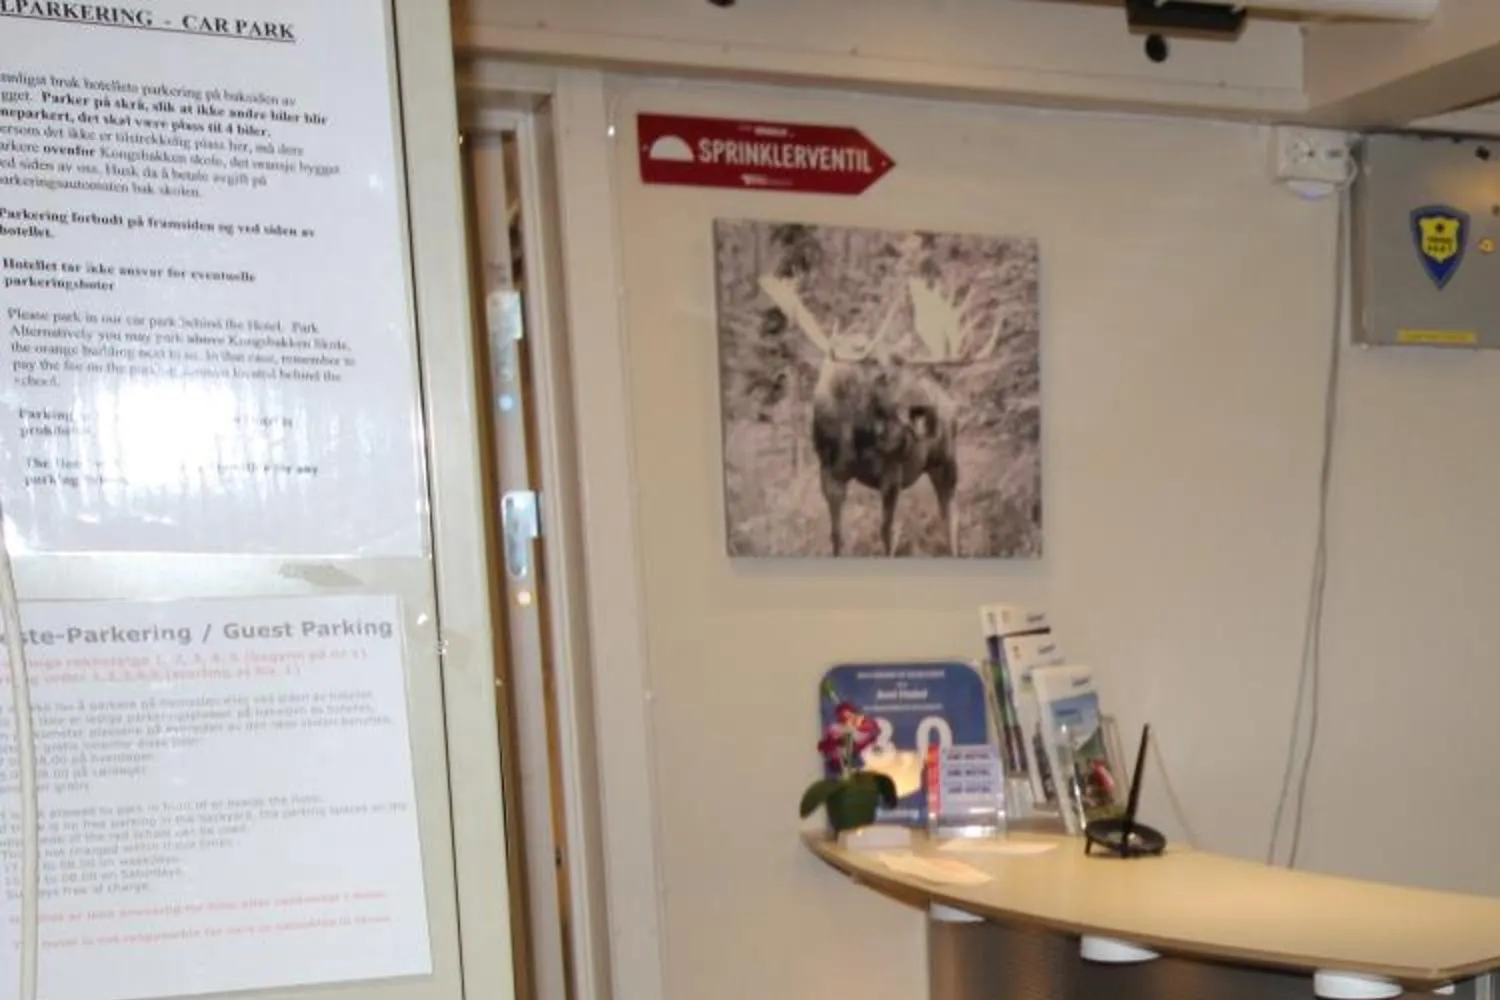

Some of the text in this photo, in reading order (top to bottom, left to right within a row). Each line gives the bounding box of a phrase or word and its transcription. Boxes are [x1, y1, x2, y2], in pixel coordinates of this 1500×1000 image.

[182, 15, 228, 34] CAR
[236, 19, 296, 39] PARK
[42, 91, 88, 106] Parker
[43, 145, 95, 158] ovenfor
[697, 138, 873, 173] SPRINKLERVENTIL
[223, 621, 294, 640] Guest
[301, 619, 393, 640] Parking
